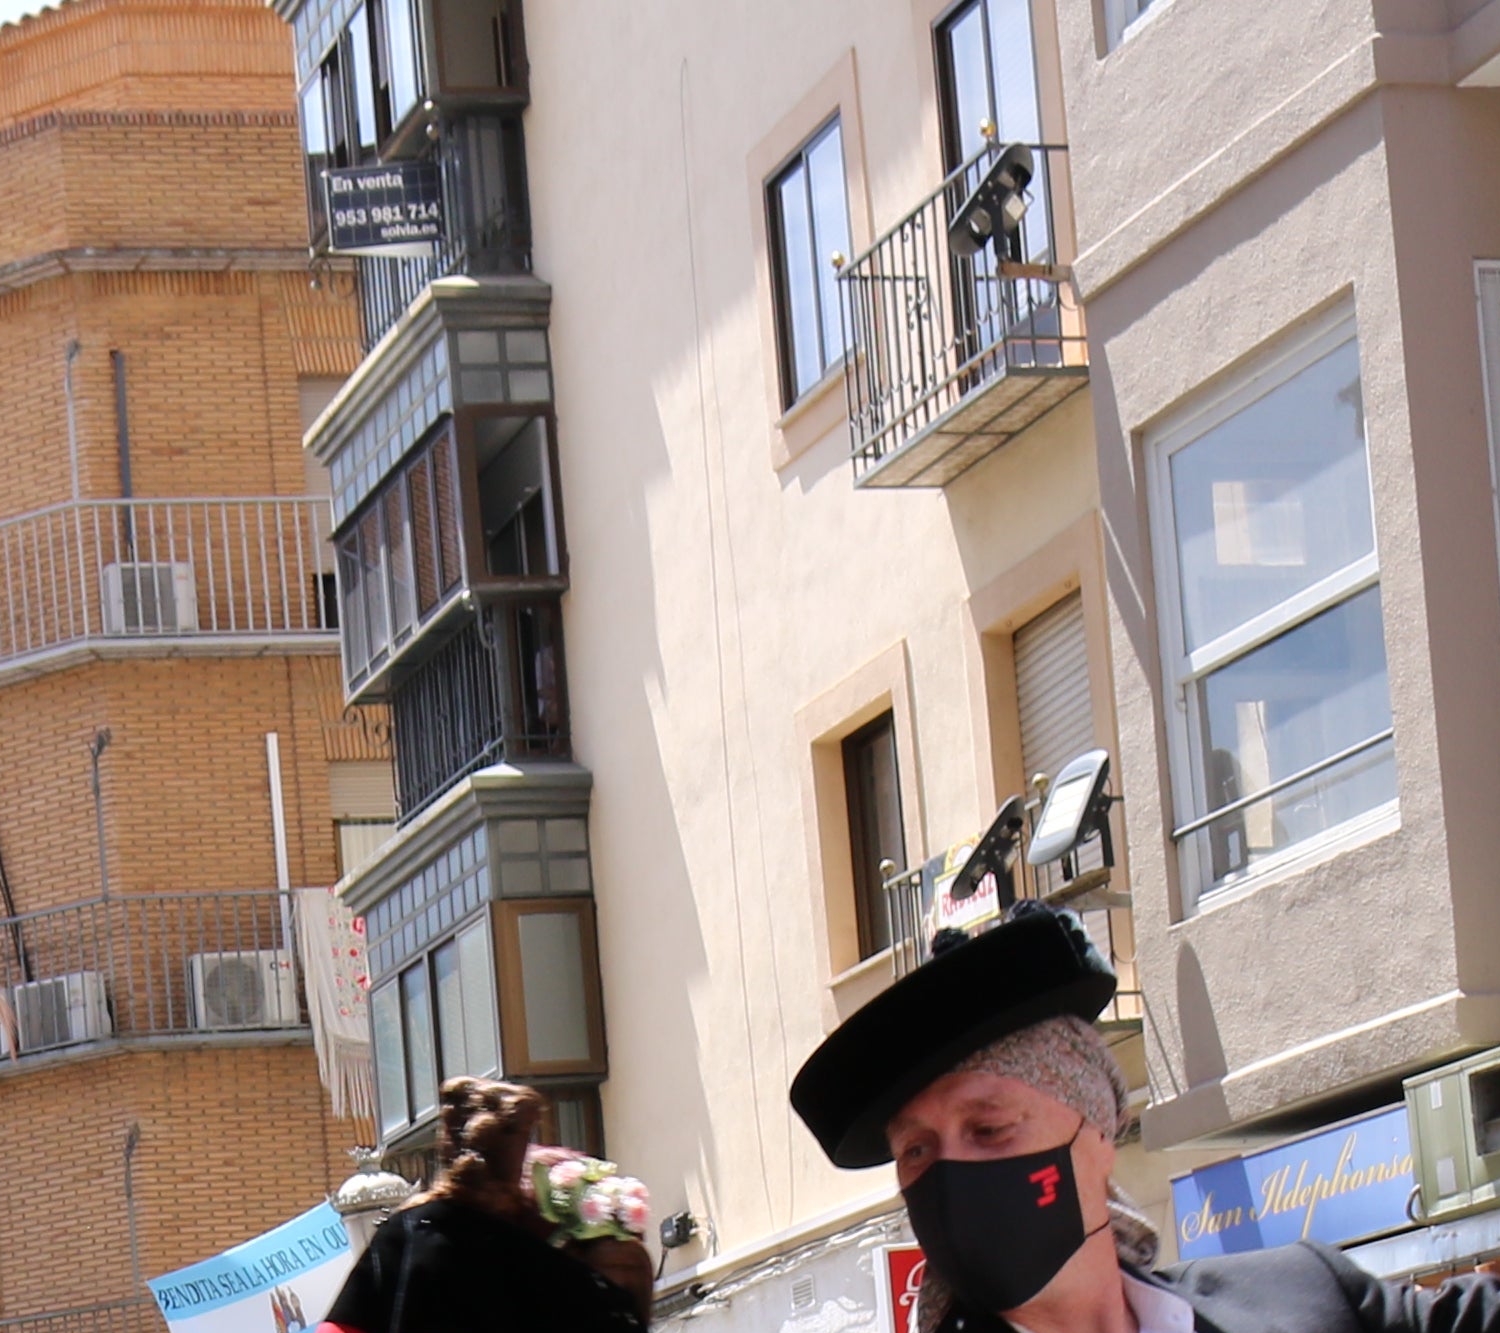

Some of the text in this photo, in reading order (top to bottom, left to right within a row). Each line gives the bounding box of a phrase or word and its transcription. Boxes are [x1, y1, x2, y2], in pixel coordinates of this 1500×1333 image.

[331, 172, 403, 193] En venta
[335, 202, 439, 227] 953 981 714
[380, 222, 438, 239] solvia.es
[1180, 1131, 1414, 1244] San Ildephonso
[158, 1277, 222, 1311] BENDITA
[217, 1268, 250, 1297] SEA
[243, 1263, 264, 1288] LA
[260, 1247, 307, 1281] HORA
[298, 1233, 326, 1263] EN
